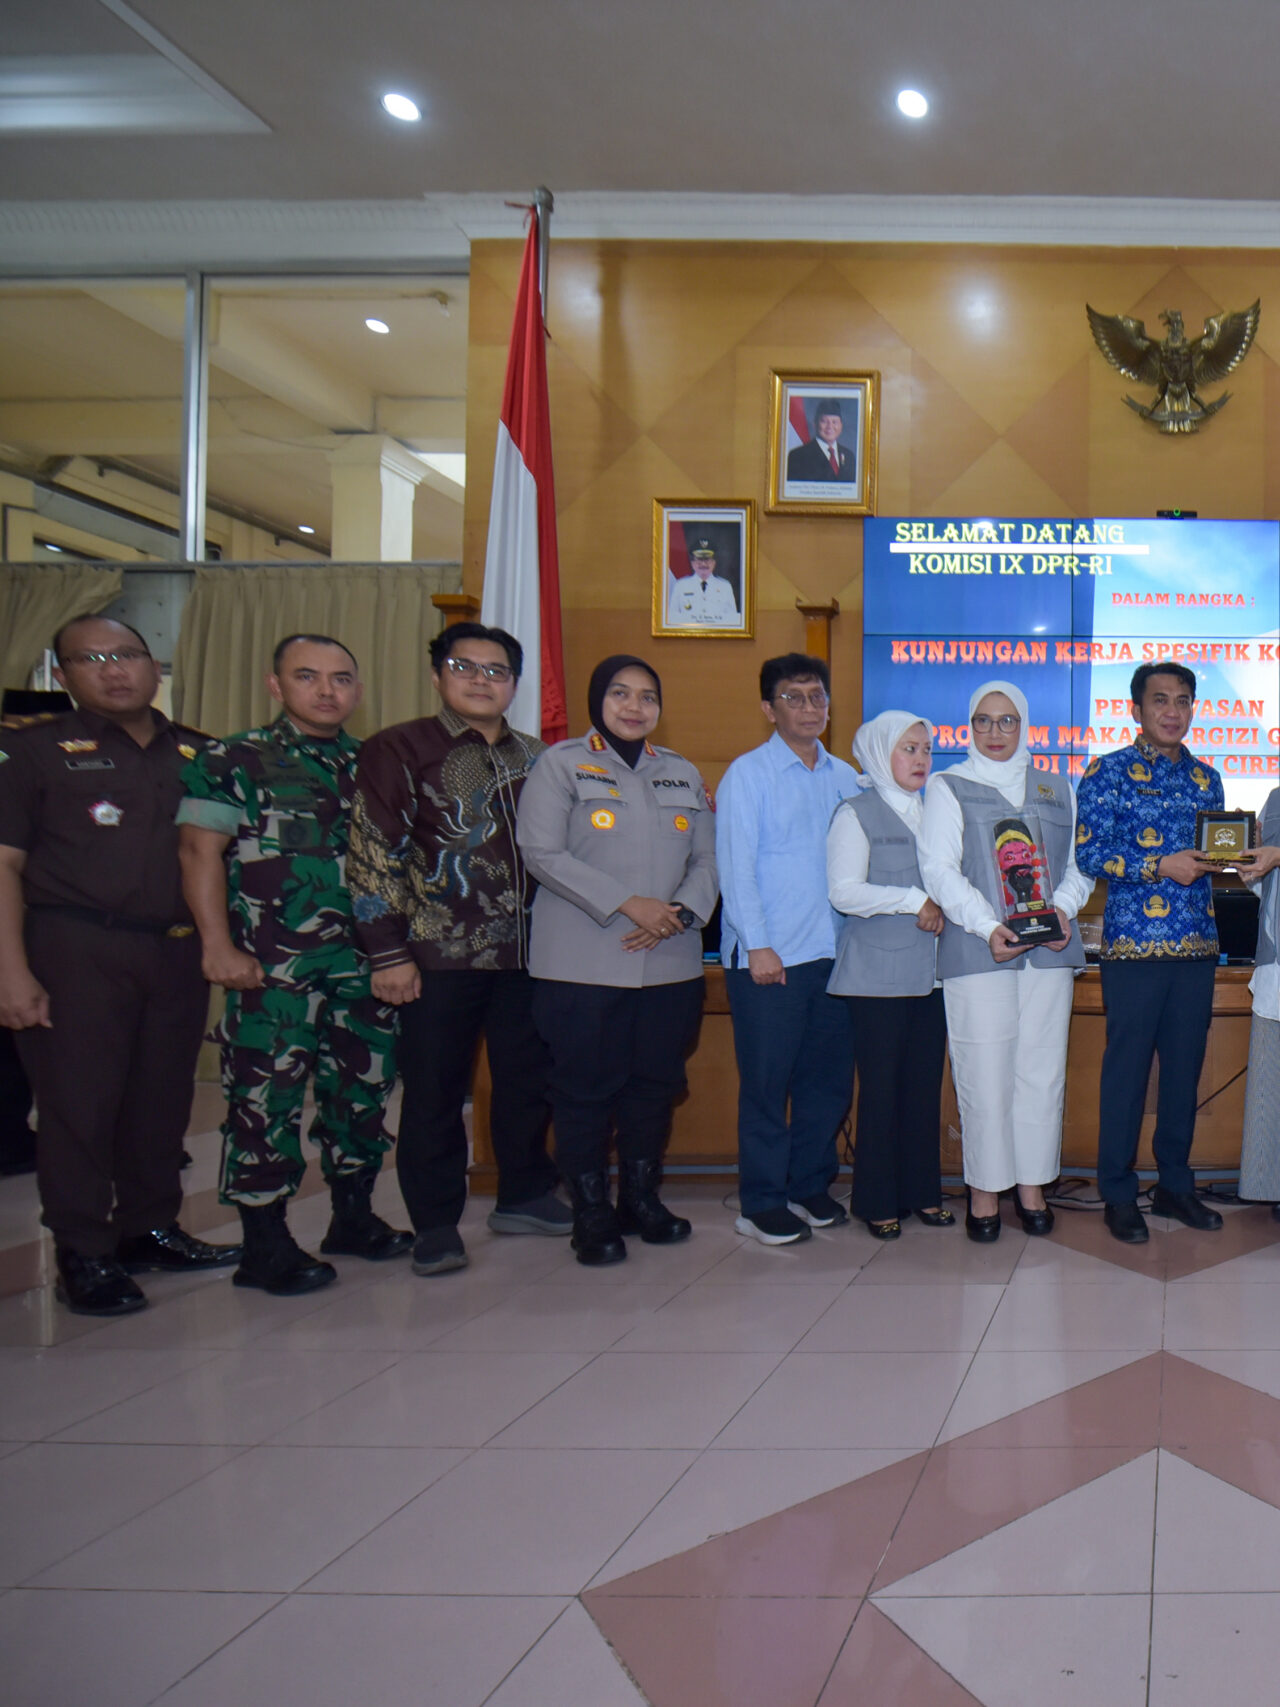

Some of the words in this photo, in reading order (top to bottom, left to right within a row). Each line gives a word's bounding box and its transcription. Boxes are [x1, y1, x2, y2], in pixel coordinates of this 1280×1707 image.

[895, 522, 1015, 543] SELAMAT
[1022, 523, 1125, 543] DATANG
[909, 554, 992, 574] KOMISI
[999, 555, 1024, 575] IX
[1032, 555, 1113, 575] DPR-RI
[1111, 592, 1170, 606] DALAM
[1175, 593, 1246, 607] RANGKA
[891, 640, 1047, 662] KUNJUNGAN
[1055, 641, 1133, 661] KERJA
[1142, 642, 1251, 662] SPESIFIK
[1057, 726, 1143, 745] MAKA
[1182, 727, 1259, 745] RGIZI
[1032, 755, 1060, 775] DI
[652, 779, 690, 789] POLRI
